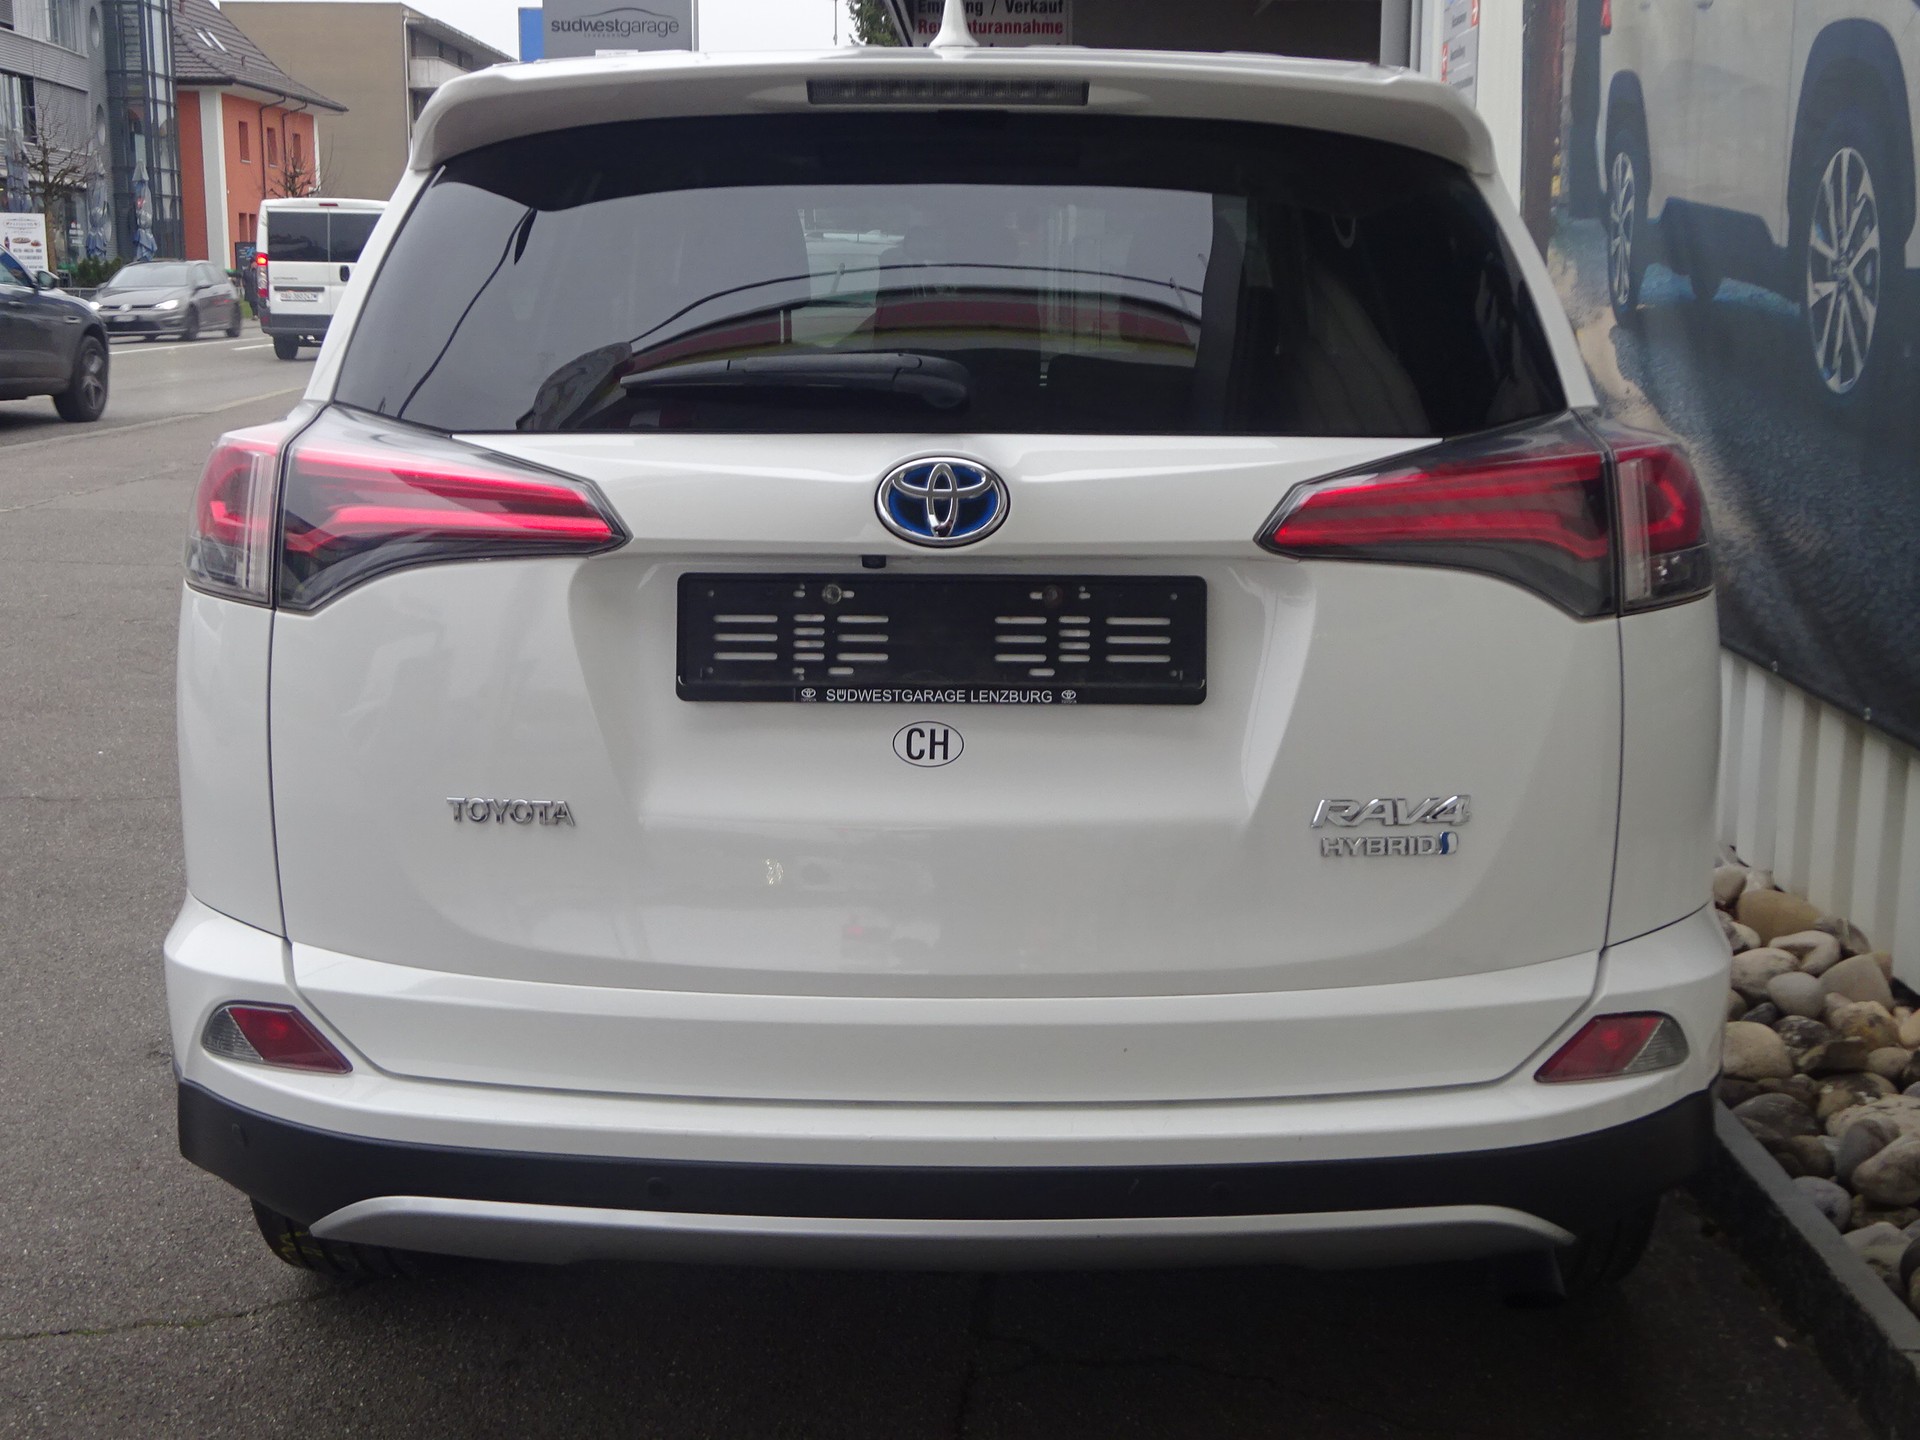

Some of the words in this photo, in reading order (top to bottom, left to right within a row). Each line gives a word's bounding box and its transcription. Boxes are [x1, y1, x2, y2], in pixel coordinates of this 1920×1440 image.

[918, 0, 984, 16] Emng
[1005, 0, 1064, 14] Verkauf
[826, 688, 966, 703] SÜDWESTGARAGE
[970, 690, 1053, 703] LENZBURG
[905, 727, 950, 761] CH
[446, 796, 576, 827] TOYOTA
[1311, 795, 1471, 828] RAV4
[1320, 836, 1438, 857] HYBRID
